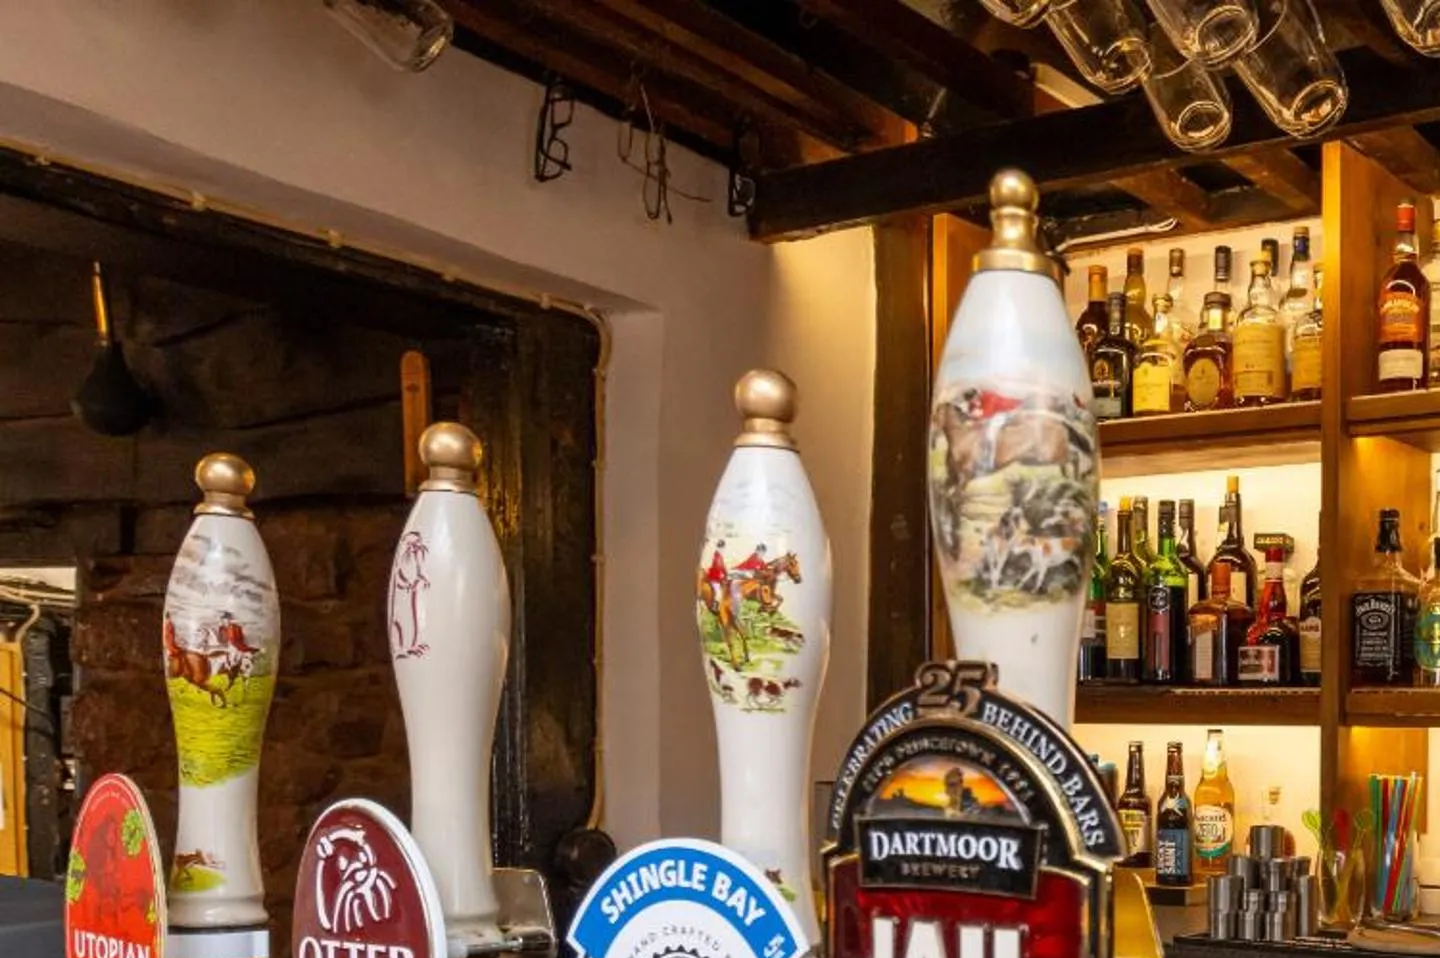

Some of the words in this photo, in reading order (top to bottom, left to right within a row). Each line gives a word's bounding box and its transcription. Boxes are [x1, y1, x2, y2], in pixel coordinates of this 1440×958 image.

[916, 662, 988, 716] 25
[982, 702, 1067, 776] BEHIND
[1062, 774, 1105, 847] BARS
[867, 830, 1024, 871] DARTMOOR
[901, 861, 981, 879] BREWERY
[601, 859, 710, 925] SHINGLE
[711, 870, 769, 928] BAY
